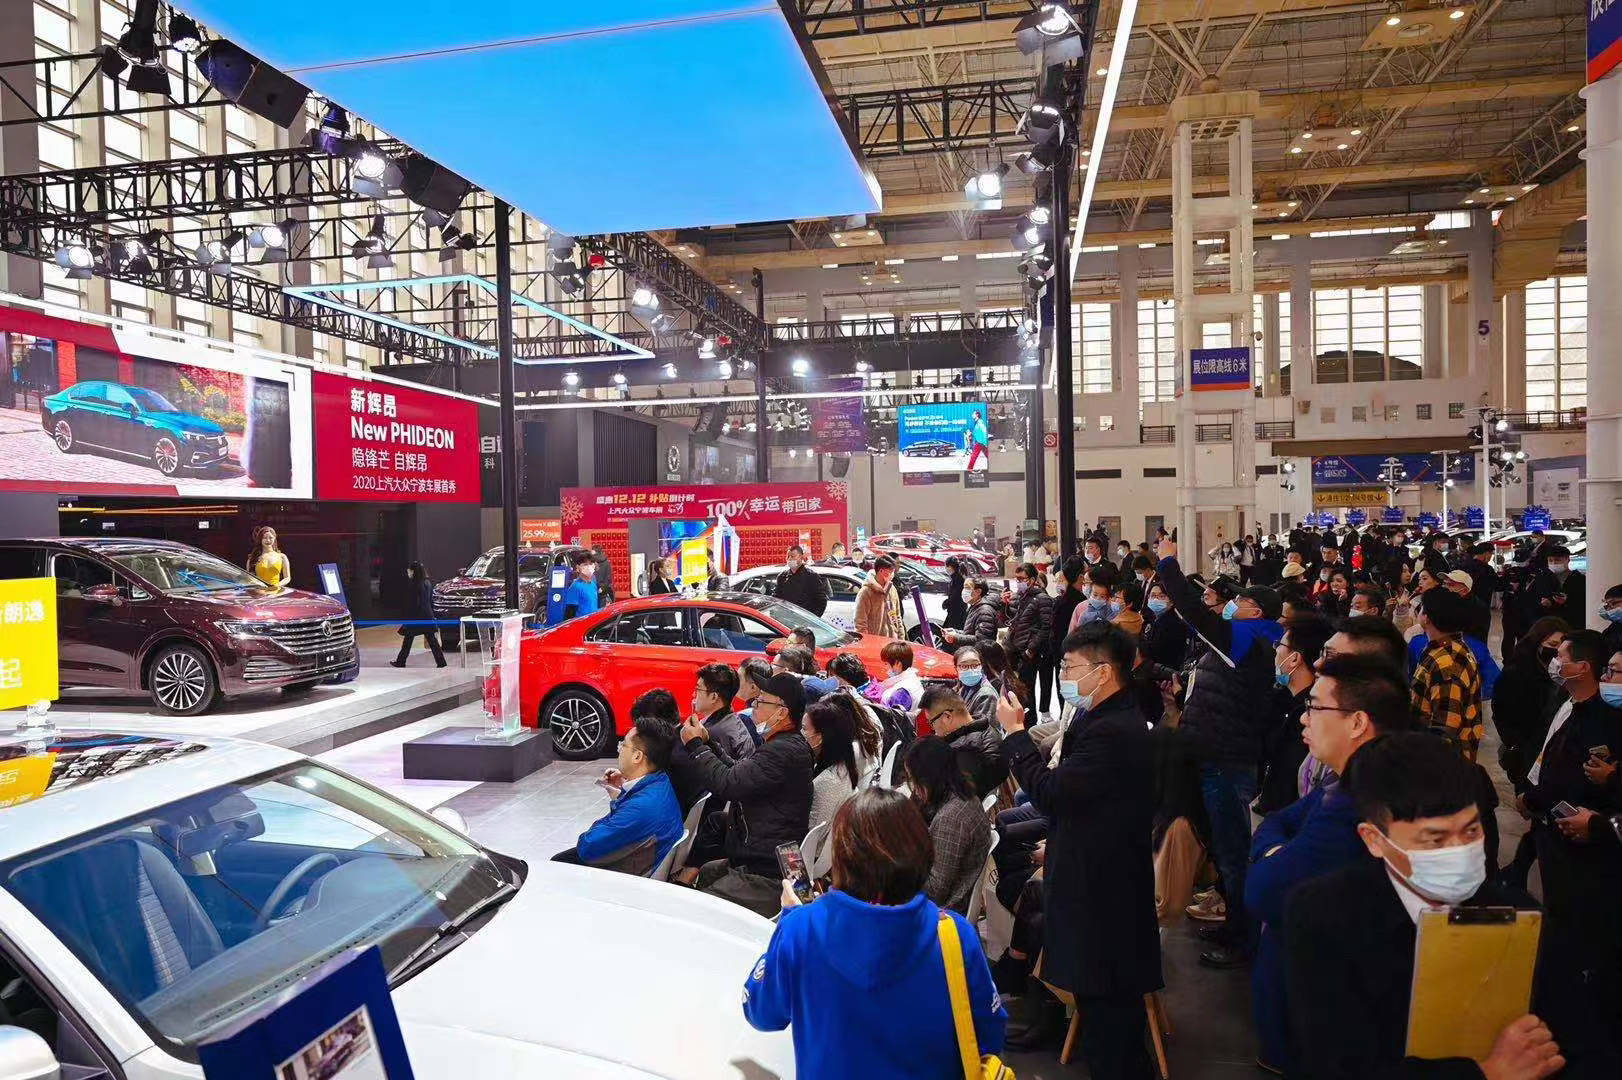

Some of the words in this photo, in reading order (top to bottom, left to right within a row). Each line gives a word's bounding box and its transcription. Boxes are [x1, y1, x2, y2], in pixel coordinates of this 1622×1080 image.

[1478, 319, 1490, 336] 5
[1193, 357, 1247, 374] 展位限高线6米
[351, 388, 396, 417] 新辉昂
[351, 416, 387, 441] New
[391, 422, 455, 449] PHIDEON
[352, 447, 391, 470] 隐锋芒
[395, 451, 428, 472] 自辉昂
[353, 475, 457, 494] 2020上汽大众宁波车展首秀
[781, 497, 821, 513] 带回家
